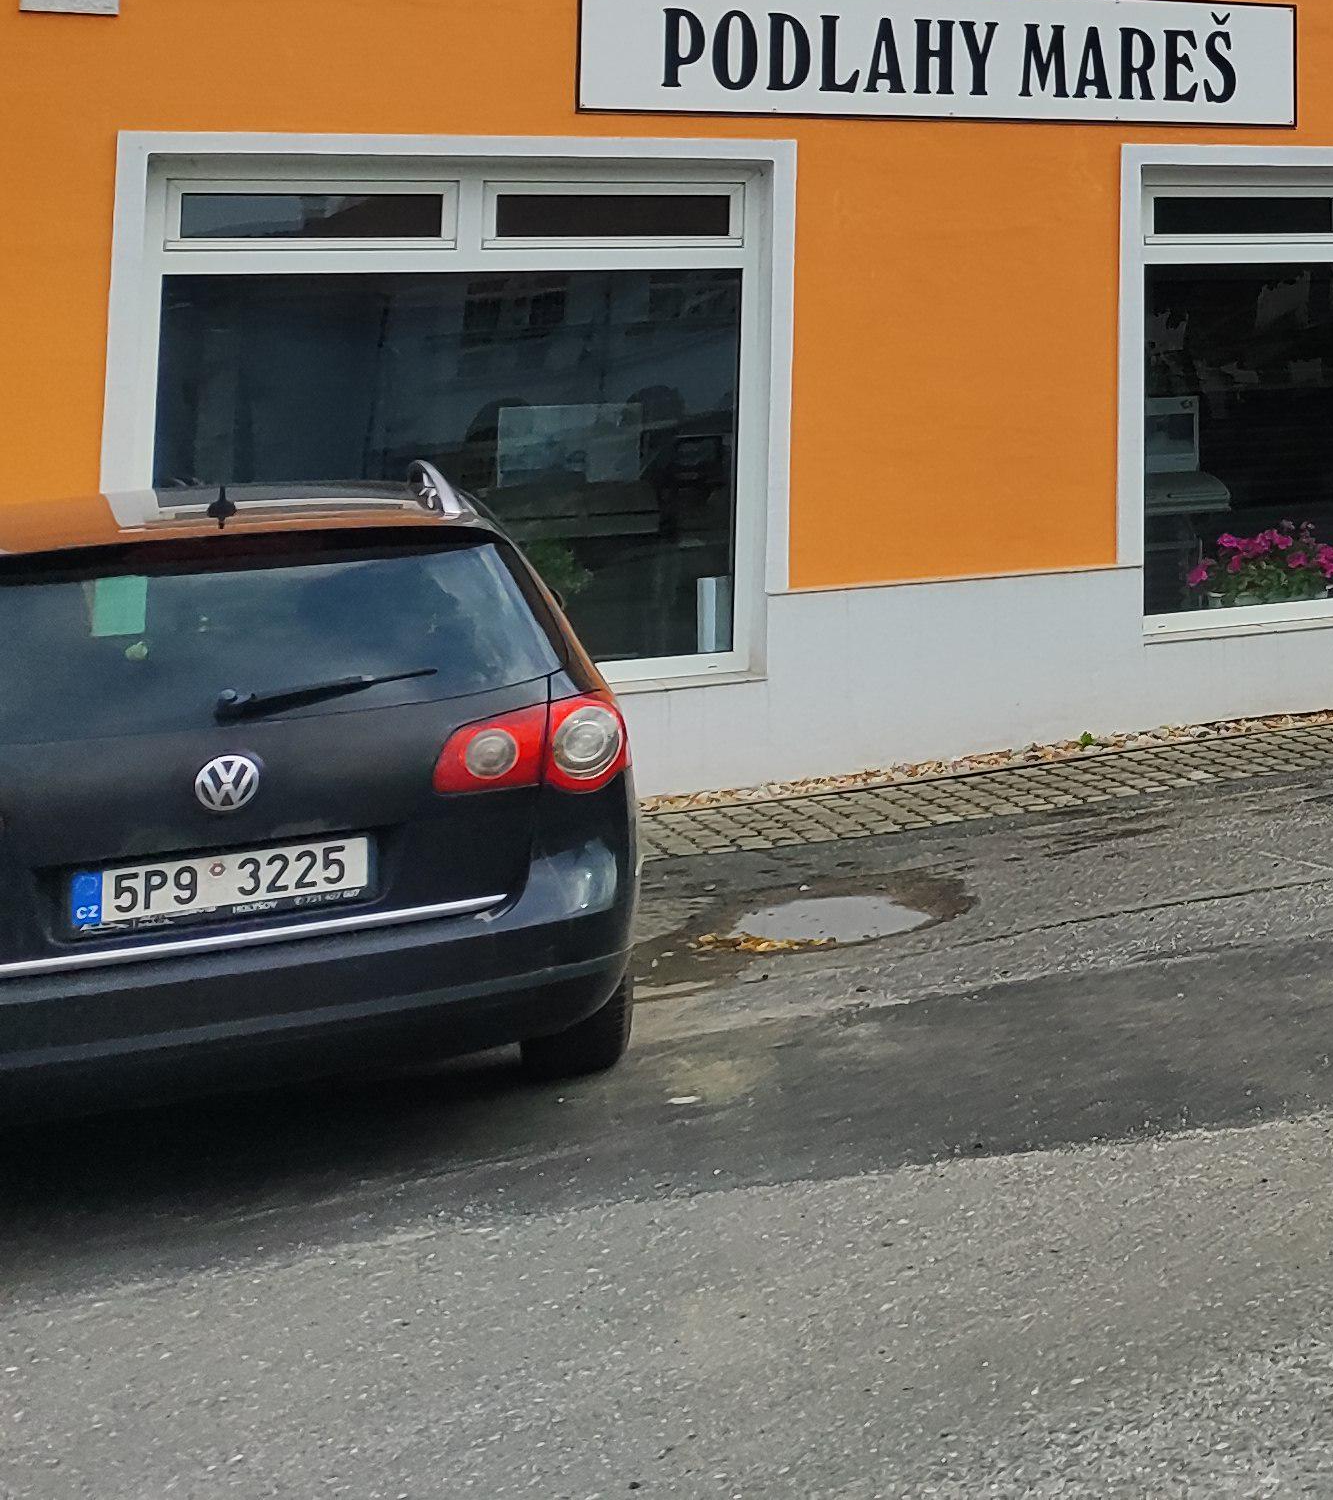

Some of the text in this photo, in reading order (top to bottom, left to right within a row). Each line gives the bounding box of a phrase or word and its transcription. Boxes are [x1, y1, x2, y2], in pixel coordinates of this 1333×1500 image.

[661, 7, 1238, 104] PODLAHY MAREŠ
[196, 756, 258, 811] VW
[113, 845, 346, 913] 5P9 3225
[76, 905, 99, 920] CZ
